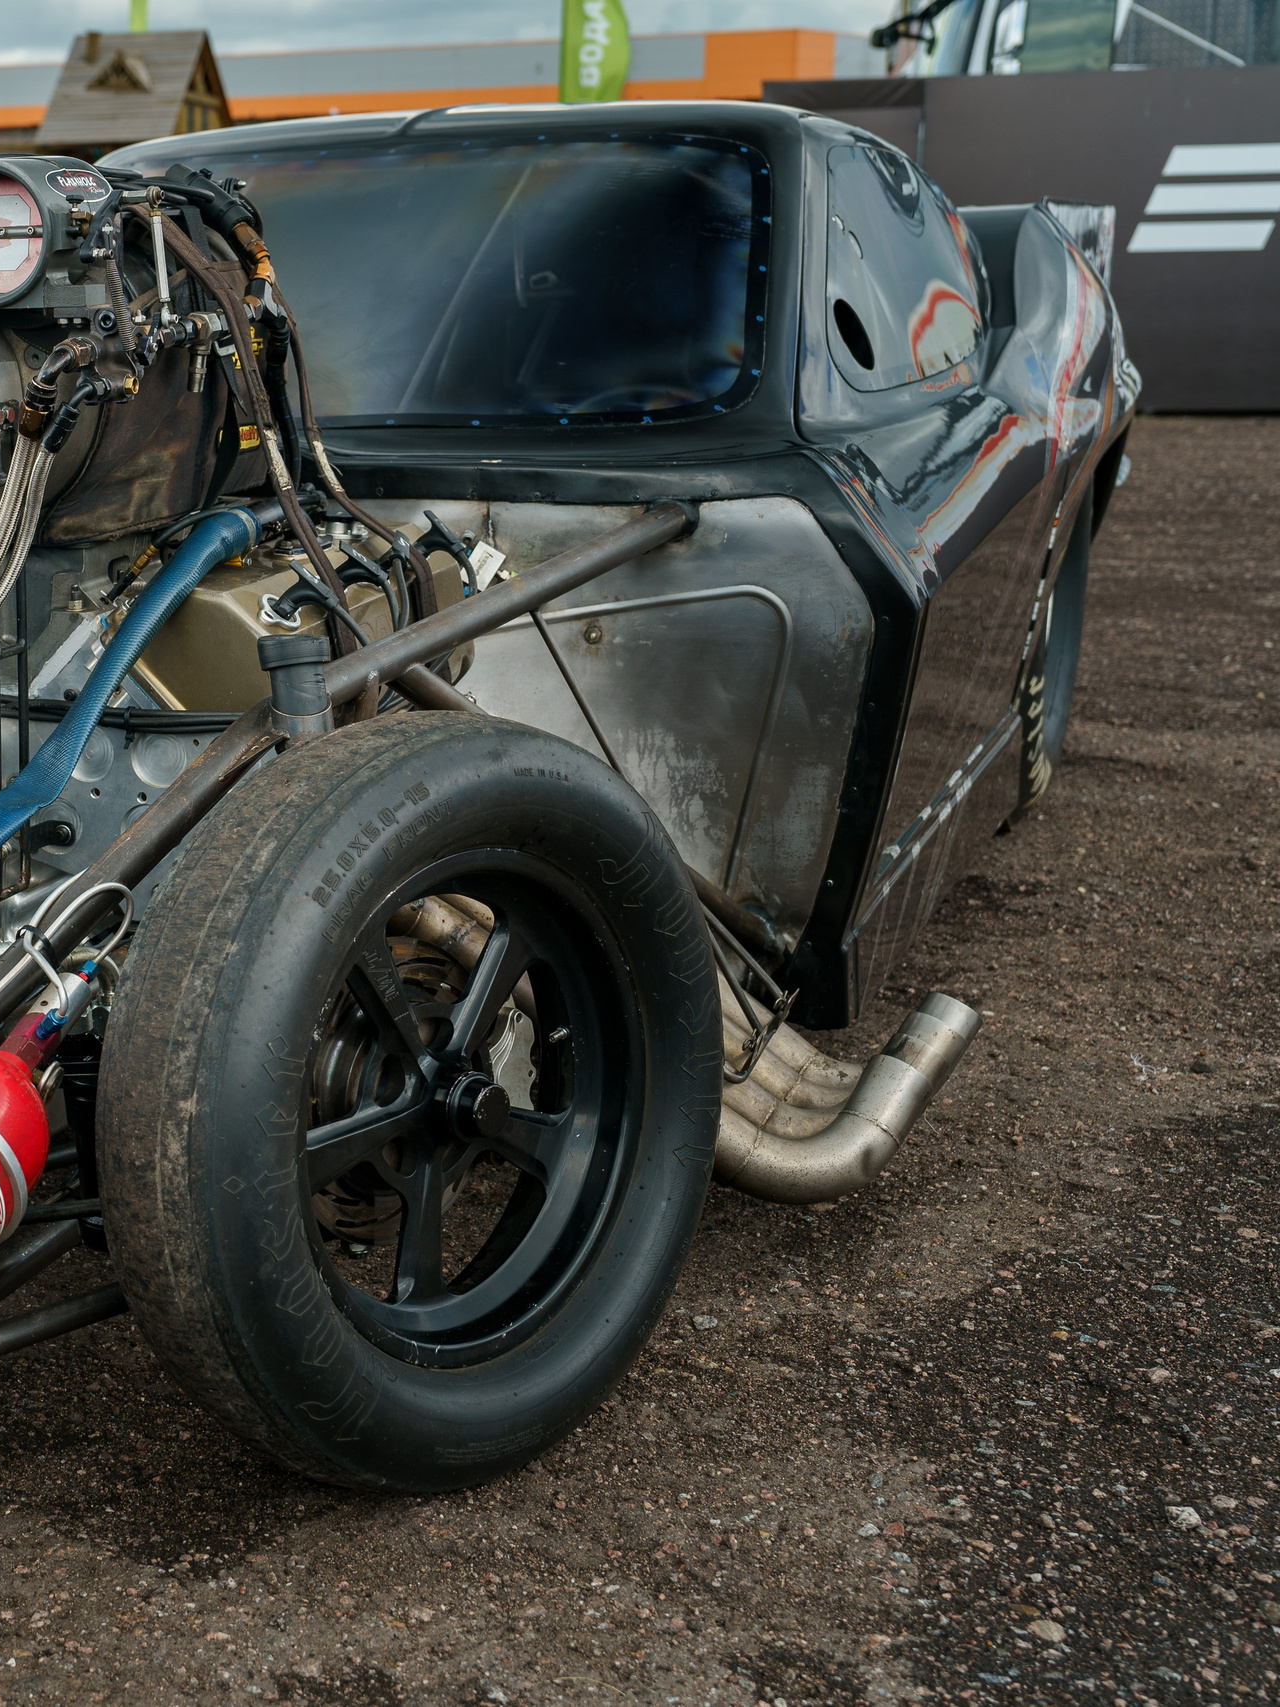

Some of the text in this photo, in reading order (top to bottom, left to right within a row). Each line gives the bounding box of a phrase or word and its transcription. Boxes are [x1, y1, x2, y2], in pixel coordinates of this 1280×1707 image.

[514, 768, 534, 777] MADE
[537, 768, 546, 778] IN
[322, 796, 453, 944] DRAG FRONT
